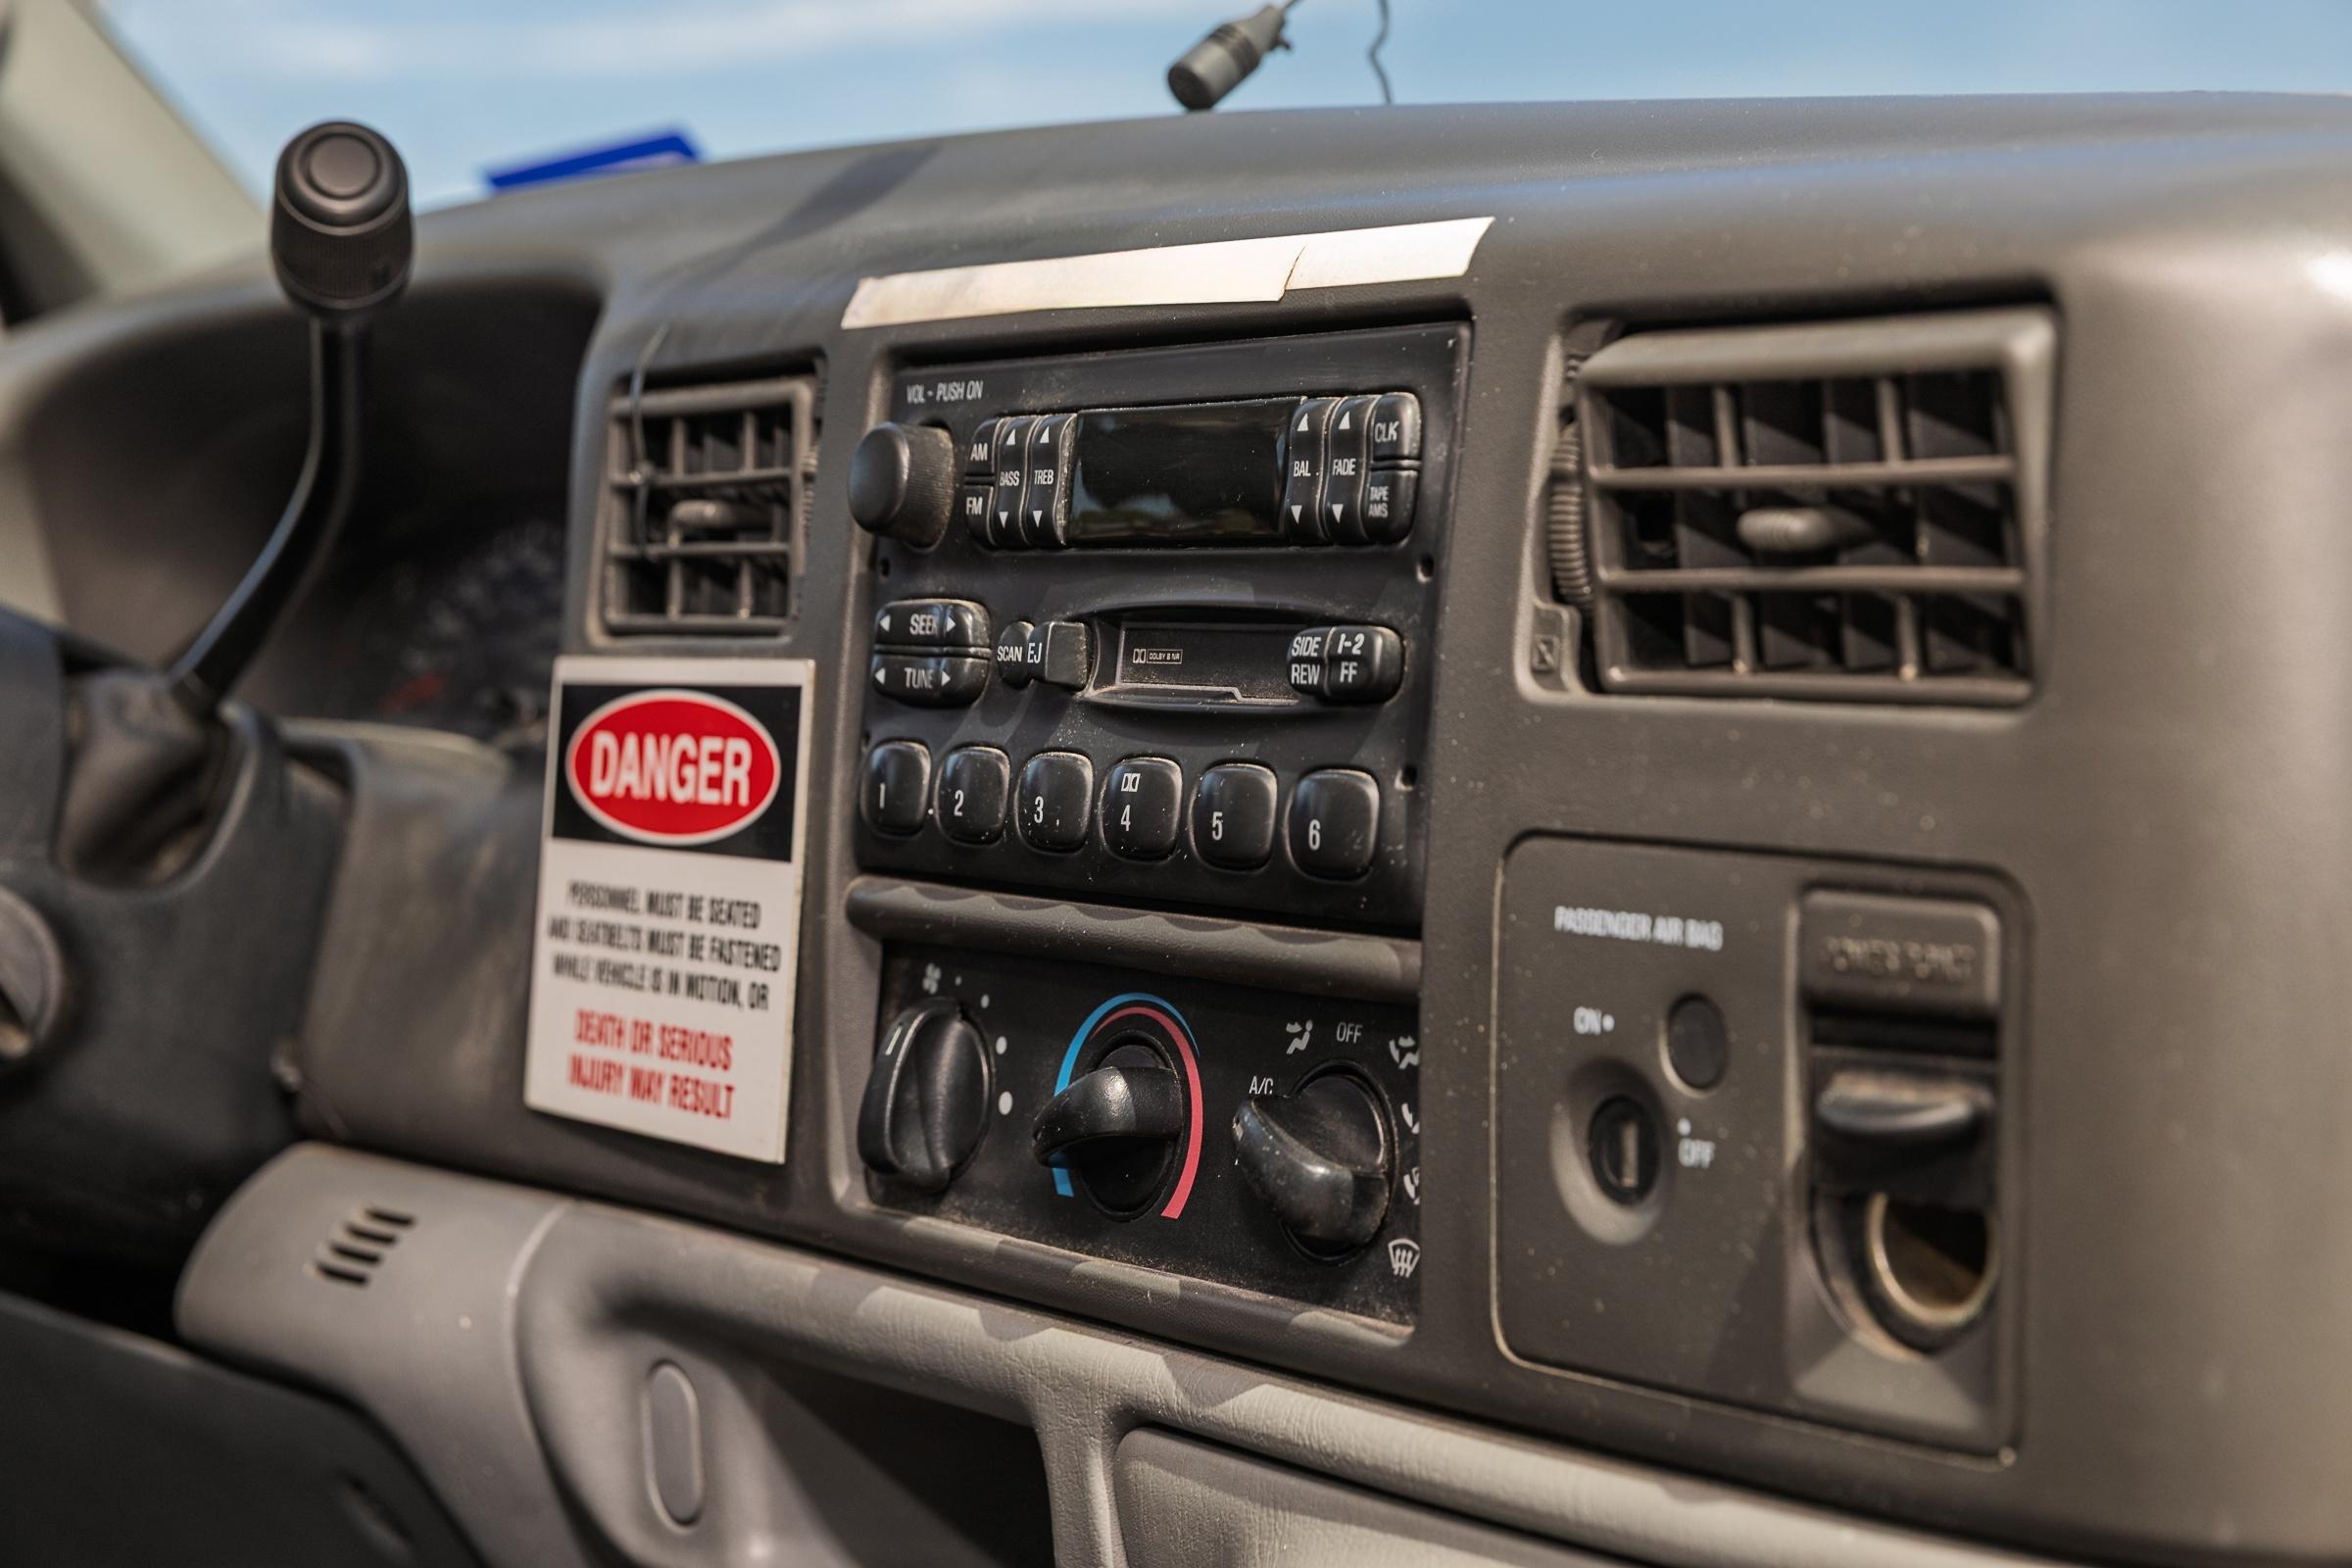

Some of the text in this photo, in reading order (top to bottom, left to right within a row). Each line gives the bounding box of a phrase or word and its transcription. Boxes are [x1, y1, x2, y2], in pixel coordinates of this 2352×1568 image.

[906, 384, 925, 403] VOL
[936, 381, 965, 401] PUSH
[966, 380, 983, 399] ON
[1375, 421, 1398, 442] CLK
[970, 443, 988, 462] AM
[1000, 469, 1020, 486] BASS
[1034, 469, 1054, 484] TREB
[1294, 461, 1310, 477] BAL
[1333, 459, 1356, 476] FADE
[1369, 486, 1389, 501] TAPE
[966, 497, 983, 515] FM
[1368, 504, 1388, 517] AMS
[998, 645, 1022, 662] SCAN
[1027, 642, 1043, 664] EJ
[1291, 636, 1321, 657] SIDE
[904, 667, 934, 690] TUNE
[1291, 663, 1321, 685] REW
[1340, 662, 1358, 683] FF
[589, 729, 752, 807] DANGER
[878, 783, 886, 808] 1
[954, 790, 964, 816] 2
[1034, 796, 1044, 824] 3
[1120, 804, 1132, 832] 4
[1211, 810, 1223, 841] 5
[1308, 819, 1321, 851] 6
[646, 889, 683, 918] MUST
[688, 896, 705, 922] BE
[709, 898, 762, 930] SEATED
[1554, 906, 1724, 952] PASSENGER AIR BAG
[647, 930, 684, 958] MUST
[689, 935, 705, 962] BE
[710, 937, 782, 972] FASTENED
[651, 967, 663, 994] IS
[749, 983, 770, 1011] OR
[1573, 1005, 1602, 1035] ON
[575, 1008, 733, 1072] DEATH OR SERIOUS
[1336, 1022, 1362, 1044] OFF
[568, 1053, 736, 1120] INJURY MAY RESULT
[1249, 1075, 1274, 1096] A/C
[1678, 1138, 1716, 1169] OFF
